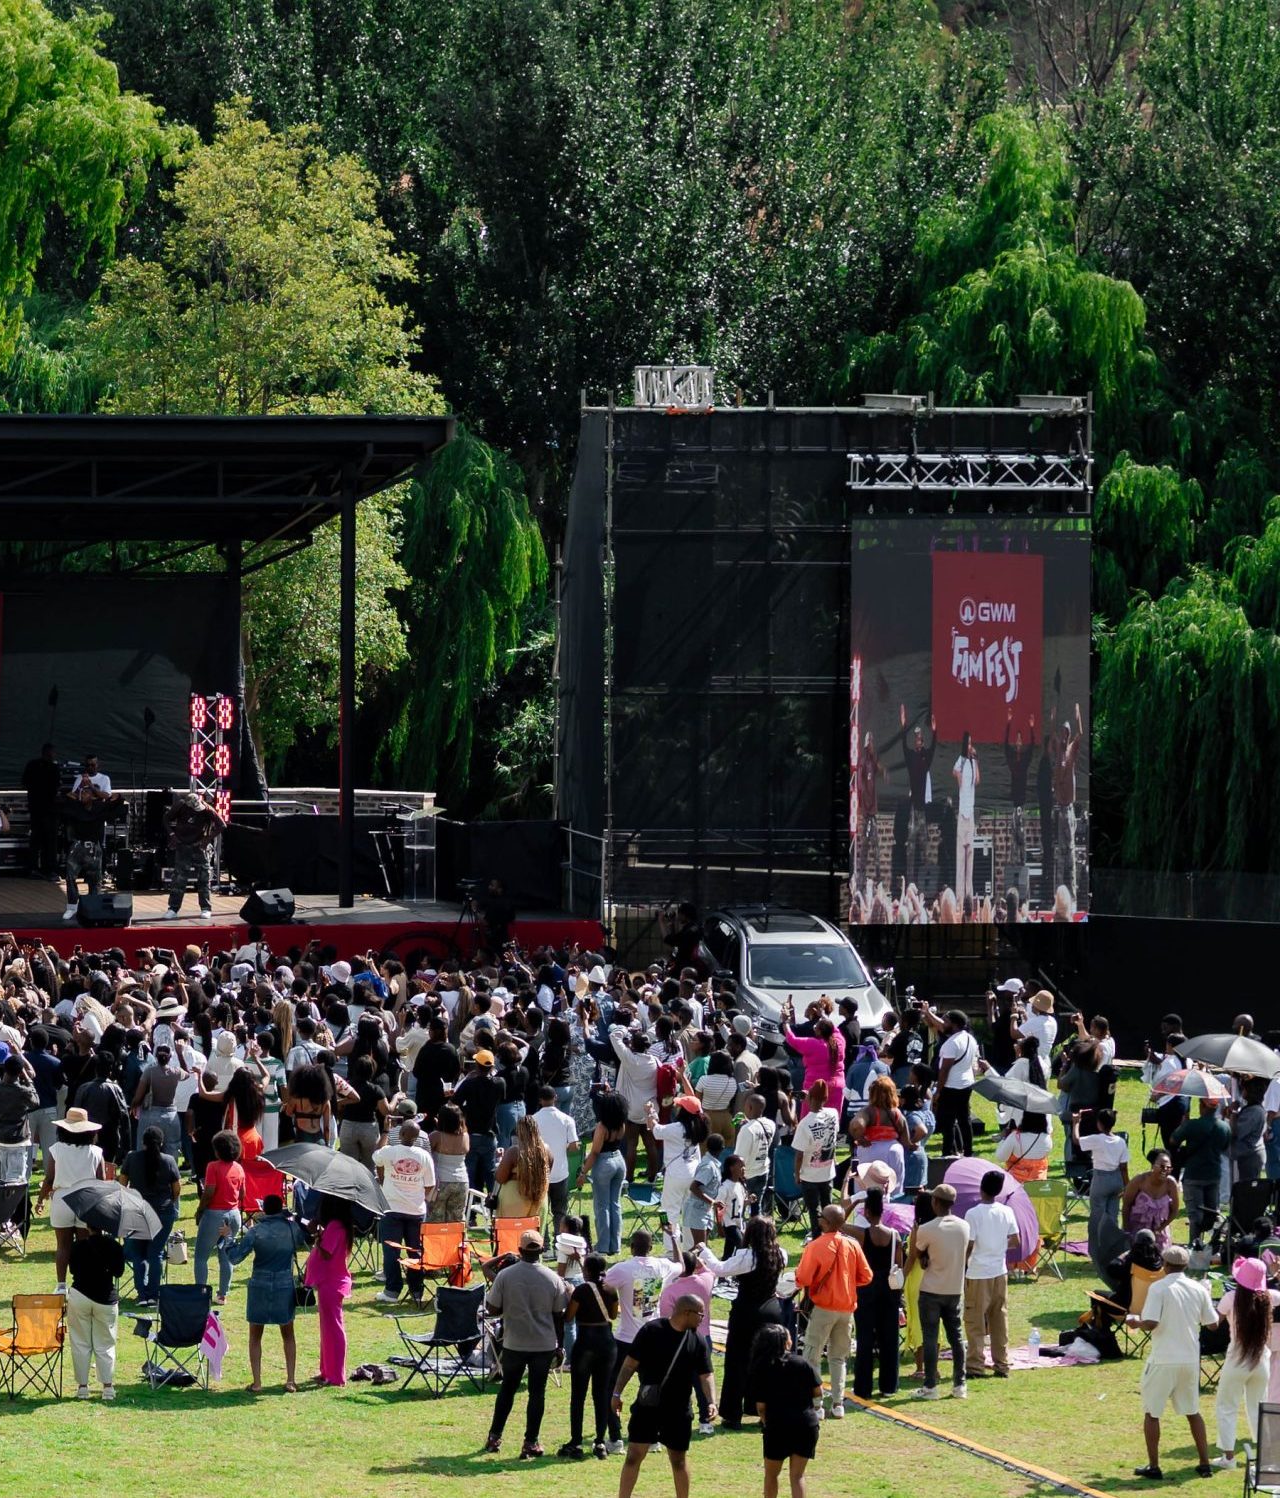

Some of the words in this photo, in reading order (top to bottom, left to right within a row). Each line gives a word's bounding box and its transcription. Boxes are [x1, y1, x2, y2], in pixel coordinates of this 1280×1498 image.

[978, 602, 1015, 622] GWM
[952, 636, 983, 687] FAM
[985, 636, 1023, 703] FEST
